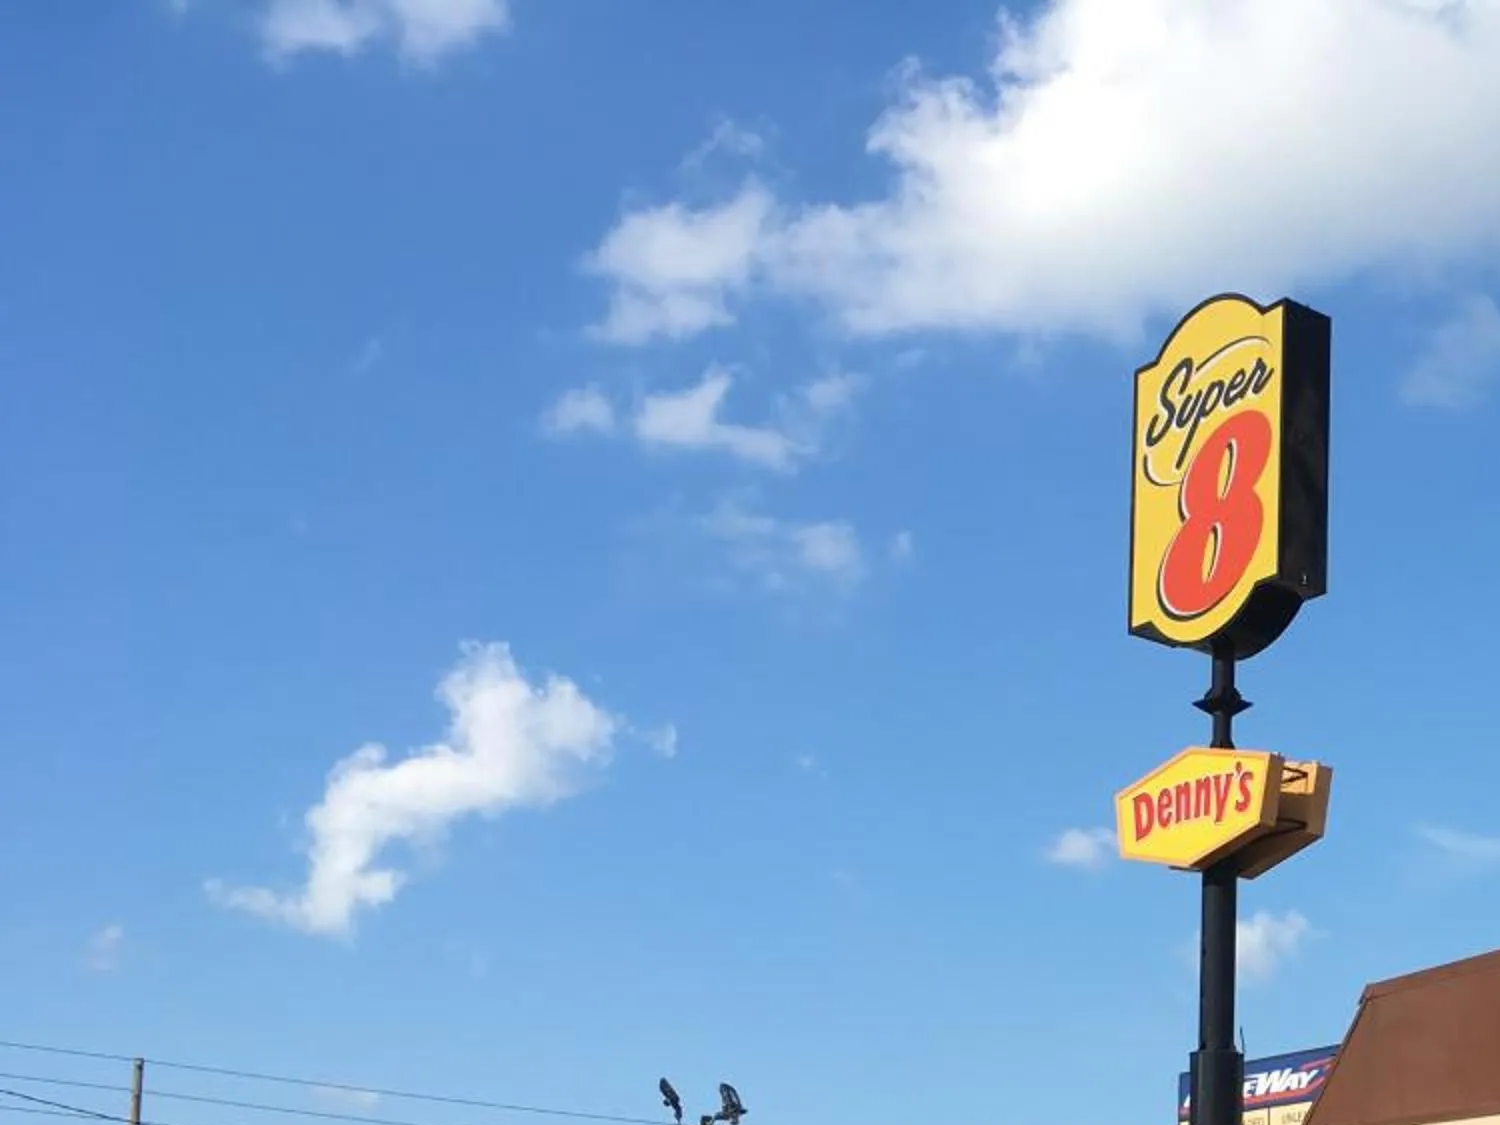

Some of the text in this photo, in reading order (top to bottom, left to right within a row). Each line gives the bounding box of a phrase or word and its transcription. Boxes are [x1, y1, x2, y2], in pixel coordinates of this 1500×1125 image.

[1146, 357, 1274, 470] Super
[1157, 409, 1272, 622] 8
[1133, 761, 1254, 842] Denny's
